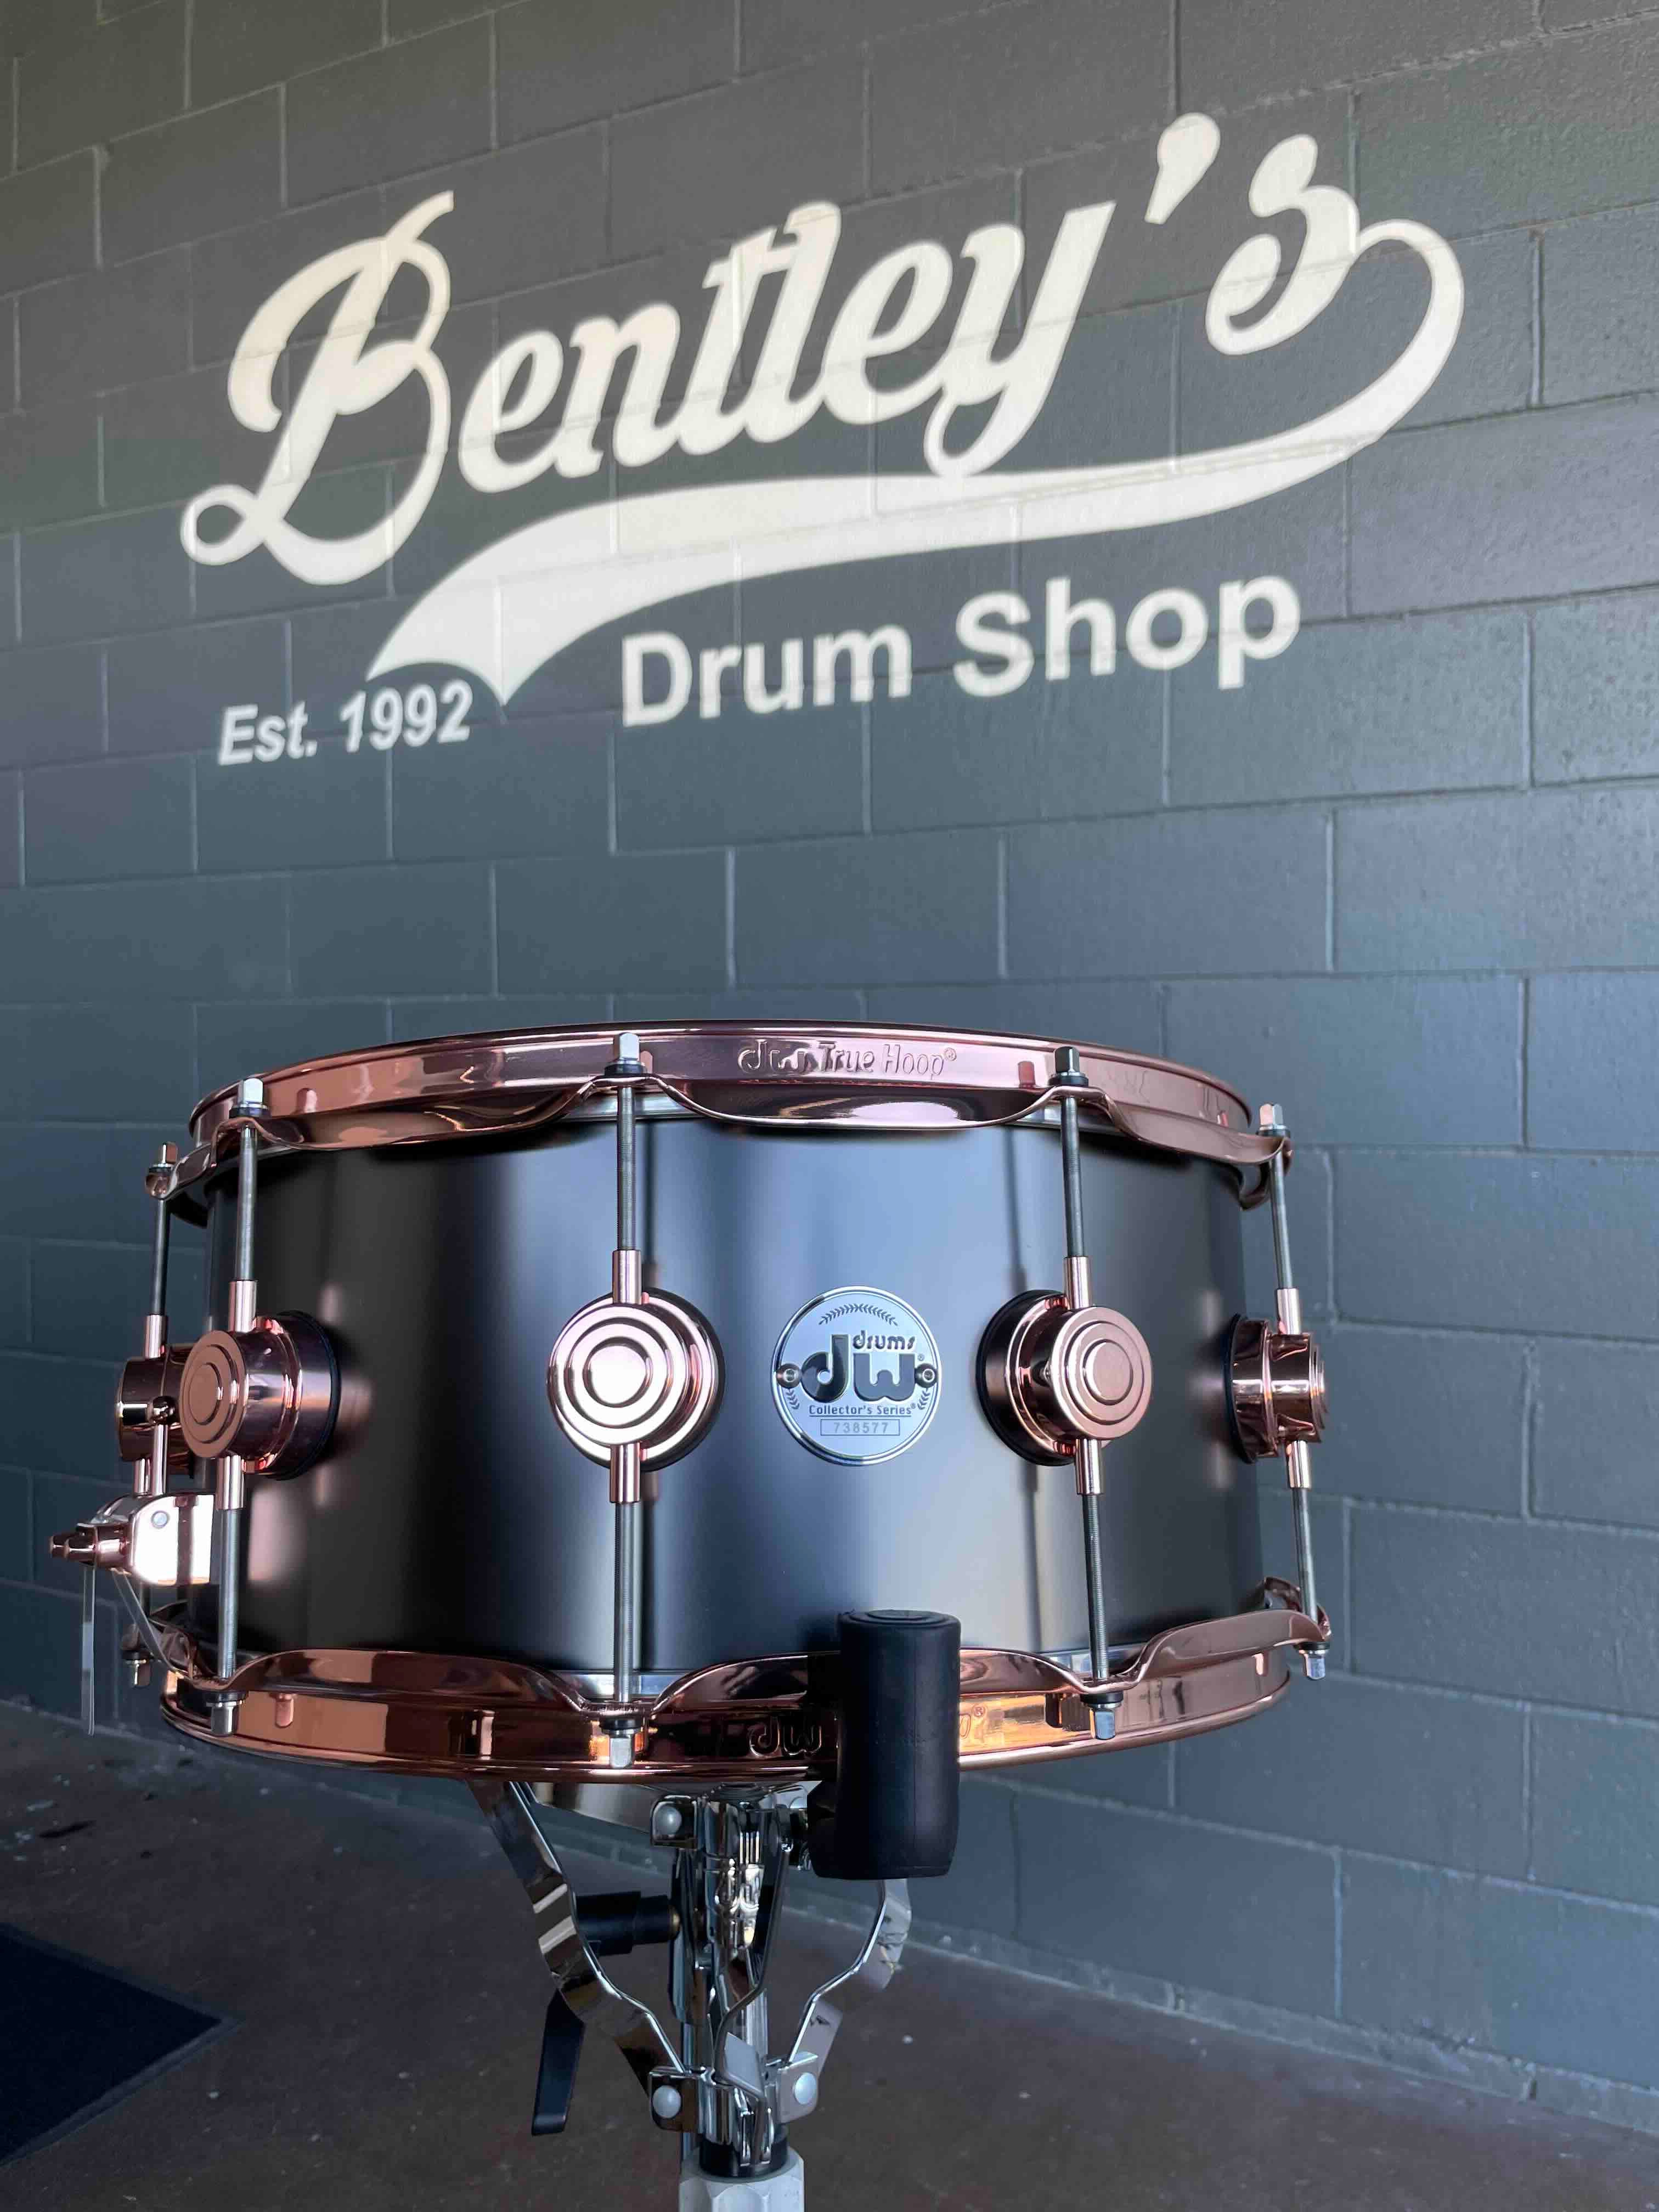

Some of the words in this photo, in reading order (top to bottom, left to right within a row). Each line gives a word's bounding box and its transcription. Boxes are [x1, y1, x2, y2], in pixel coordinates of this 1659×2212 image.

[179, 112, 1465, 585] Bentley's
[621, 625, 913, 727] Drum
[953, 575, 1301, 697] Shop
[218, 701, 318, 766] Est.
[340, 679, 473, 752] 1992
[816, 1040, 875, 1073] True
[852, 1330, 916, 1350] drums
[809, 1404, 872, 1415] Collector's
[833, 1421, 889, 1434] 738577
